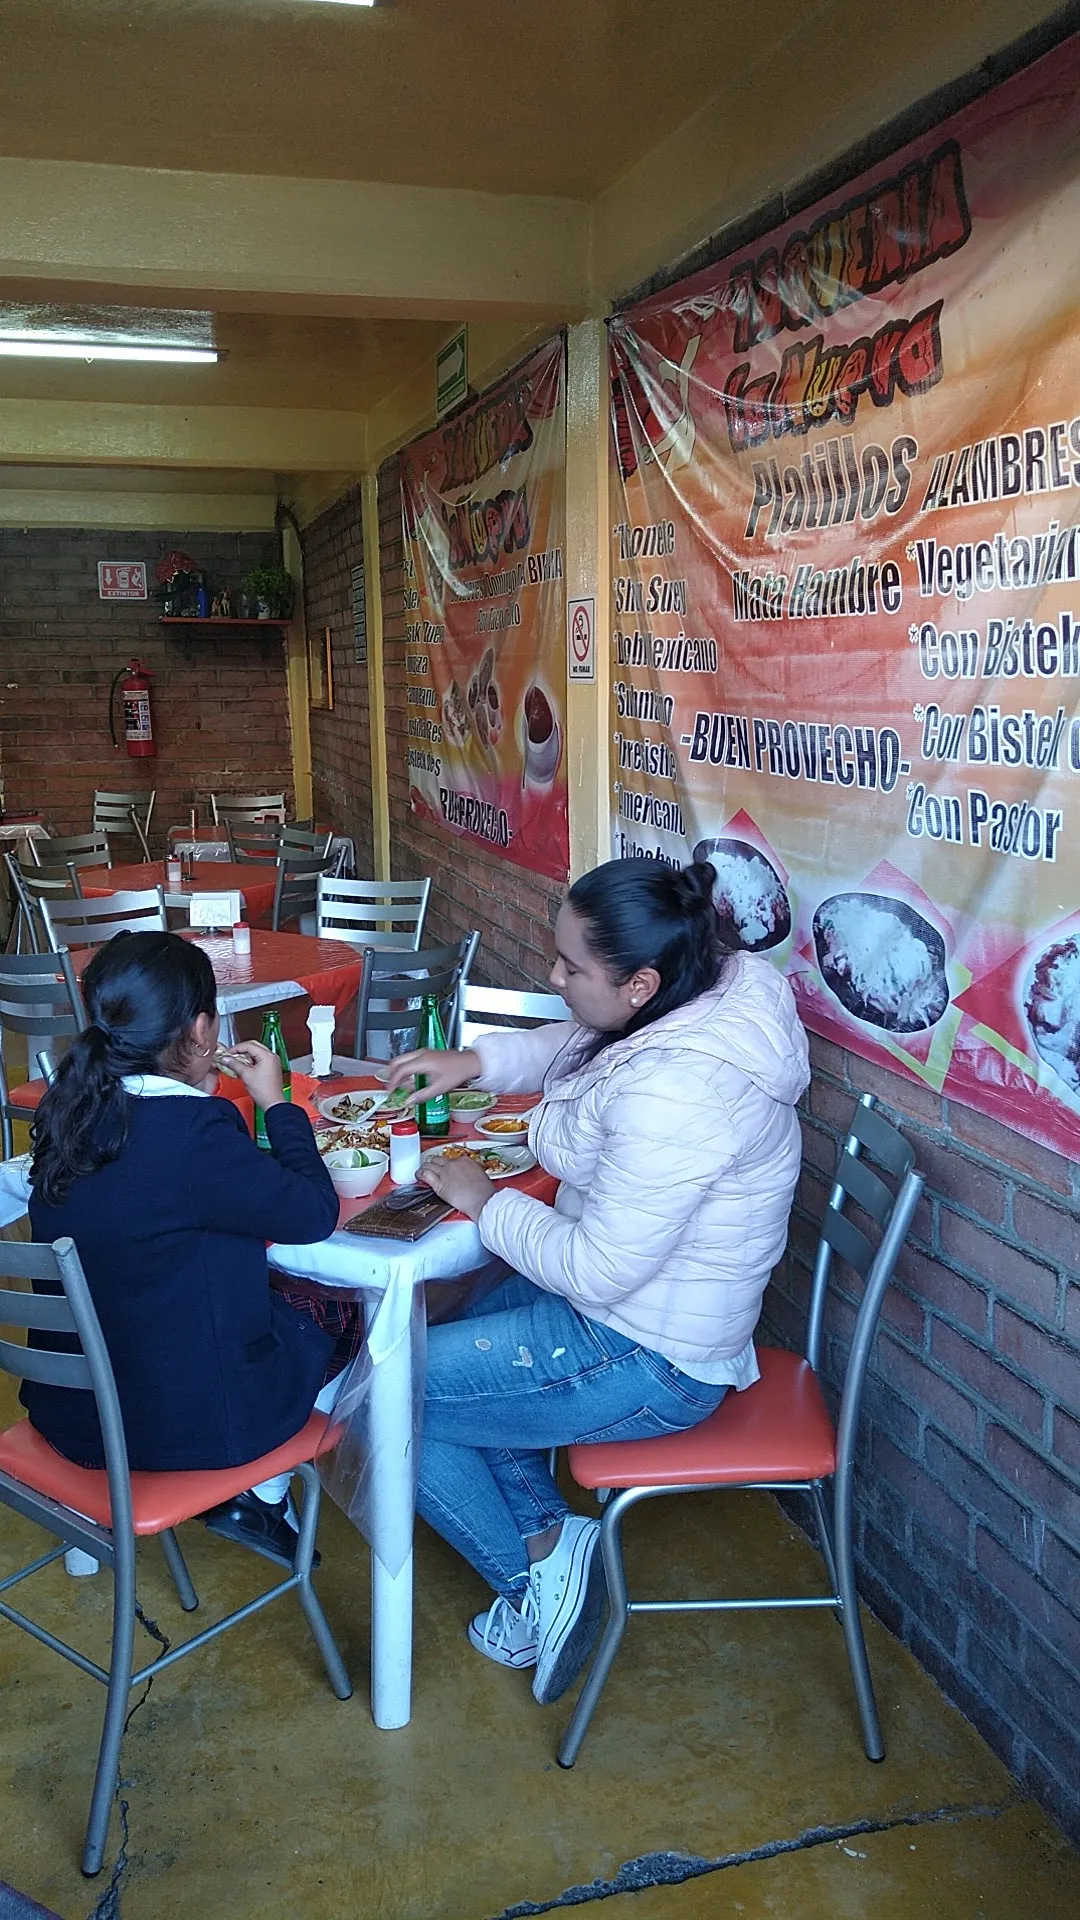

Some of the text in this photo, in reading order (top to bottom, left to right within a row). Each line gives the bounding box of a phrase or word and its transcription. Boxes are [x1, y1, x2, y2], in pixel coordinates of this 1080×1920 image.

[744, 433, 920, 540] Platillos
[732, 556, 902, 622] Mata Hambre
[967, 704, 1066, 771] Bistek
[967, 788, 1063, 863] Pastor
